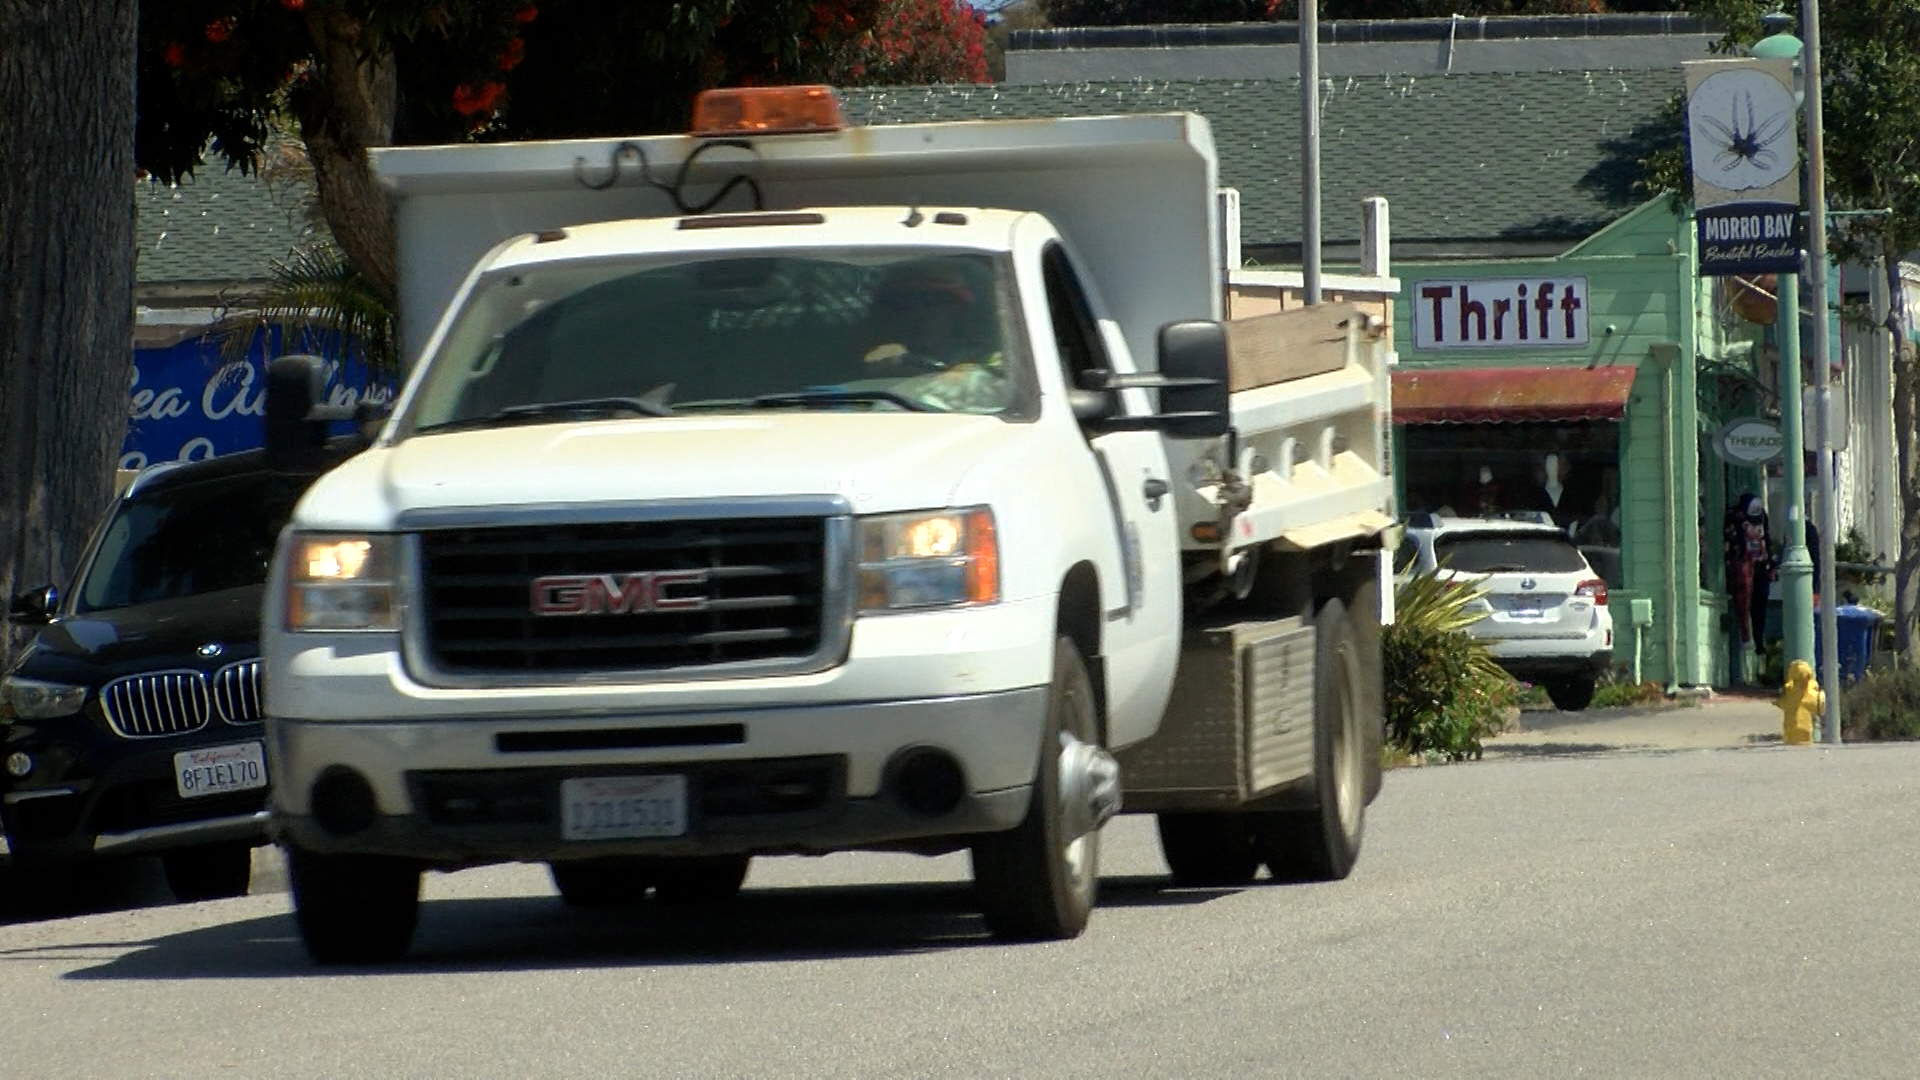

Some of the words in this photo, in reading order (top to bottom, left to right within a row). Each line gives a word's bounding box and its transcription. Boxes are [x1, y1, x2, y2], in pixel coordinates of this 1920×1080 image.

[1705, 215, 1760, 241] MORRO
[1764, 213, 1794, 238] BAY
[1705, 244, 1754, 262] Beautiful
[1754, 242, 1796, 260] Beaches
[1422, 281, 1581, 342] Thrift
[529, 570, 708, 616] GMC
[182, 760, 259, 791] 8FIE170
